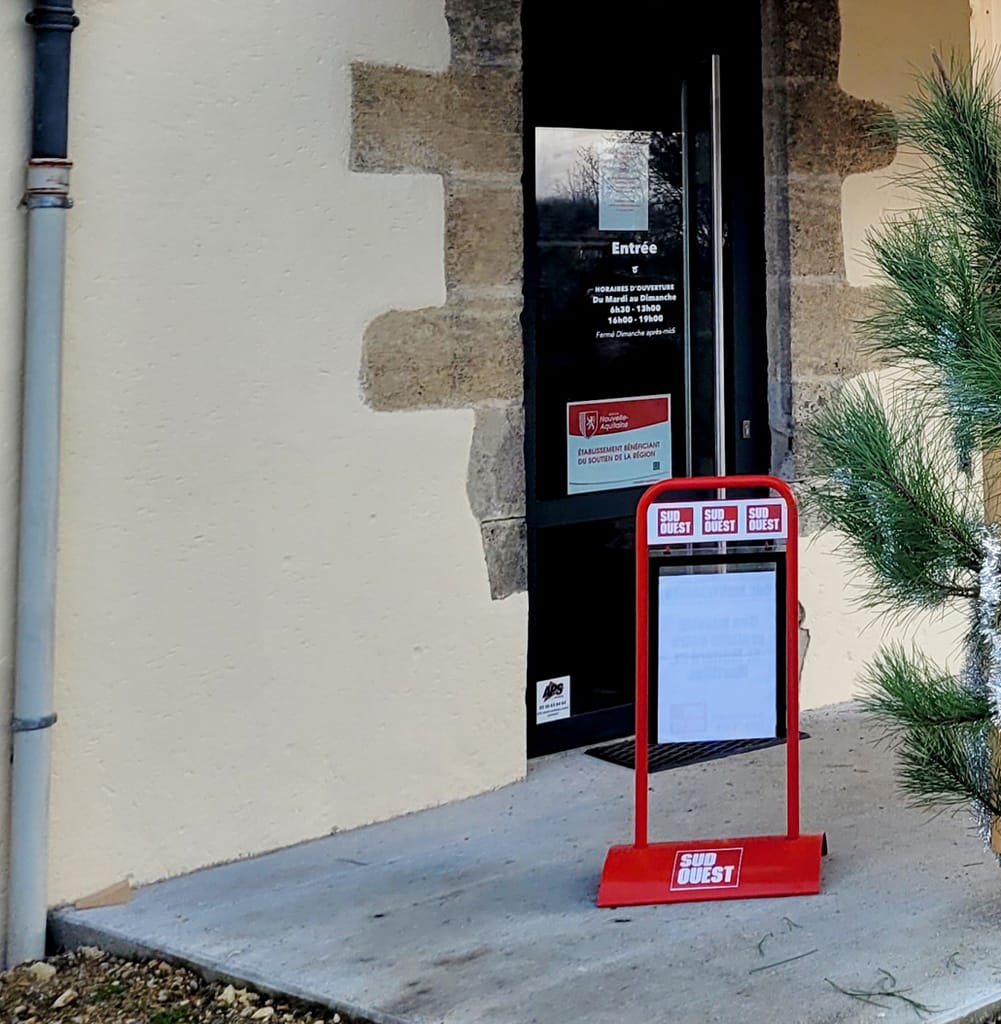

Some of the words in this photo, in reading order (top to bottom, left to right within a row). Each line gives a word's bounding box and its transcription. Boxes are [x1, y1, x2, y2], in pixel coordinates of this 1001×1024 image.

[611, 241, 658, 255] Entrée
[594, 285, 629, 293] HORAIRES
[629, 283, 675, 292] D'OUVERTURE
[592, 295, 604, 304] Du
[605, 294, 628, 303] Mardi
[629, 295, 639, 303] au
[640, 292, 677, 302] Dimanche
[609, 305, 631, 314] 6h30
[636, 304, 661, 313] 13h00
[607, 316, 633, 324] 16h00
[638, 314, 664, 323] 19h00
[616, 329, 645, 337] Dimanche
[577, 444, 623, 456] ÉTABLISSEMENT
[624, 440, 661, 452] BÉNÉFICIANT
[577, 456, 587, 465] DU
[588, 454, 613, 464] SOUTIEN
[614, 453, 623, 461] DE
[624, 452, 633, 460] LA
[633, 450, 656, 459] RÉGION
[660, 510, 680, 522] SUD
[704, 508, 725, 520] SUD
[748, 506, 769, 519] SUD
[660, 521, 691, 534] OUEST
[704, 519, 736, 533] OUEST
[748, 518, 780, 531] OUEST
[679, 852, 717, 867] SUD
[677, 865, 736, 885] OUEST
